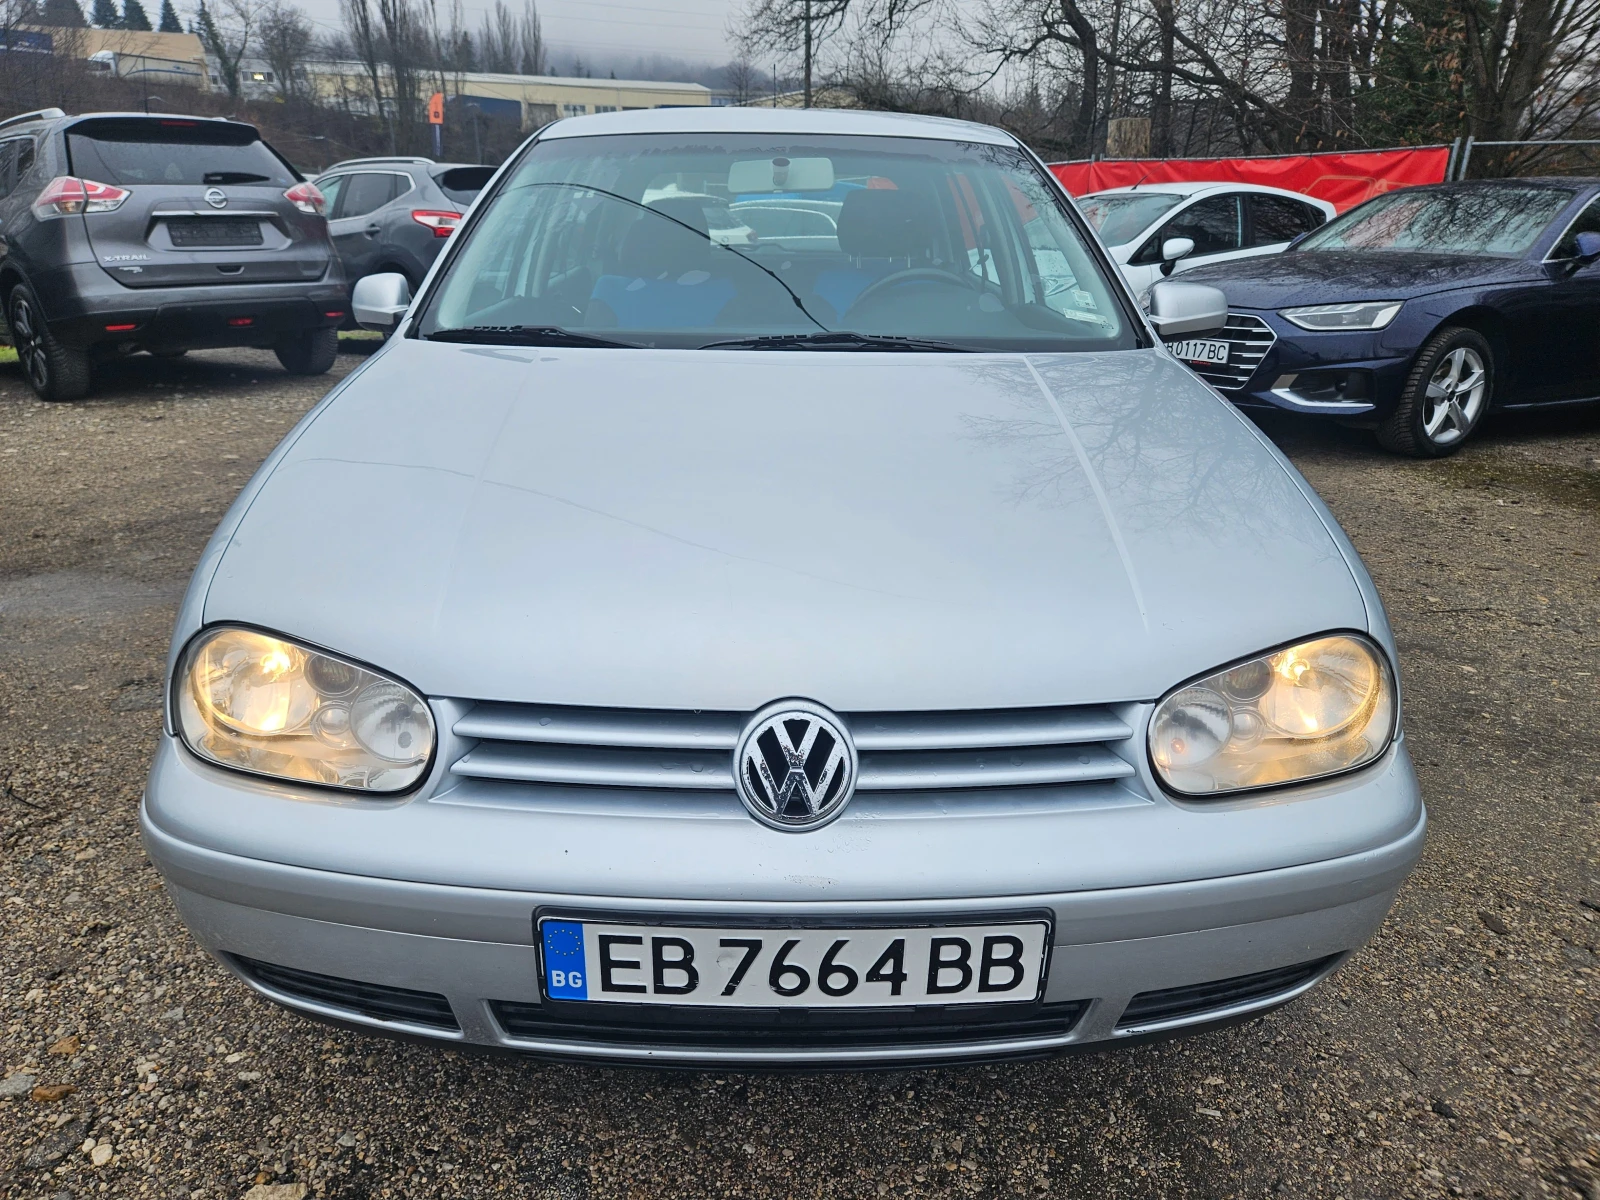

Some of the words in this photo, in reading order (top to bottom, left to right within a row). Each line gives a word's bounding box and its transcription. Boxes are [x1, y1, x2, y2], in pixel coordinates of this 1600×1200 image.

[103, 254, 151, 262] X-TRAIL
[742, 711, 850, 822] VW
[551, 970, 583, 988] BG
[598, 934, 699, 995] EB
[719, 938, 907, 997] 7664
[926, 935, 1025, 995] BB
